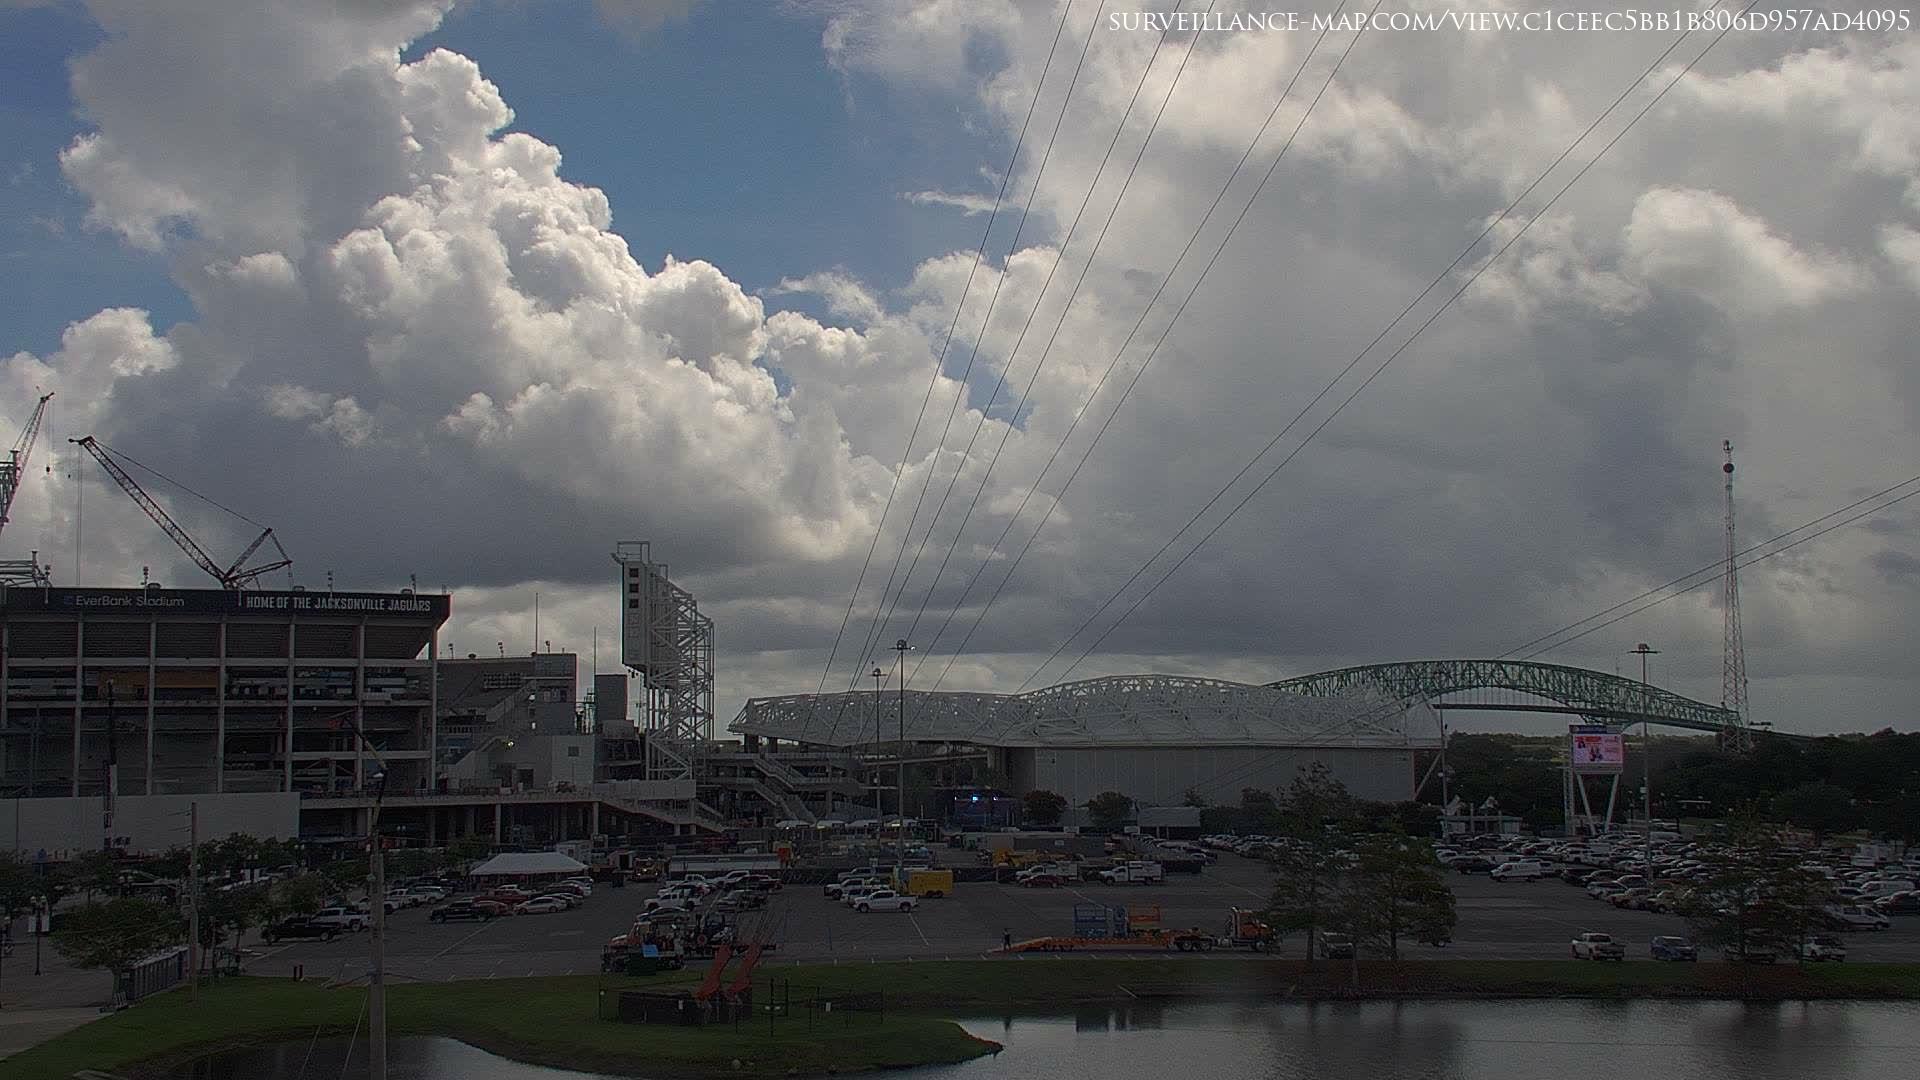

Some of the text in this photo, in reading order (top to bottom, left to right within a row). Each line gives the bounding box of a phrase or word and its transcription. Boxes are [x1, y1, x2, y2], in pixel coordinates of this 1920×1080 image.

[75, 595, 185, 608] EverBank Stadium
[246, 596, 432, 612] HOME OF THE JACKSONVILLE JAGUARS
